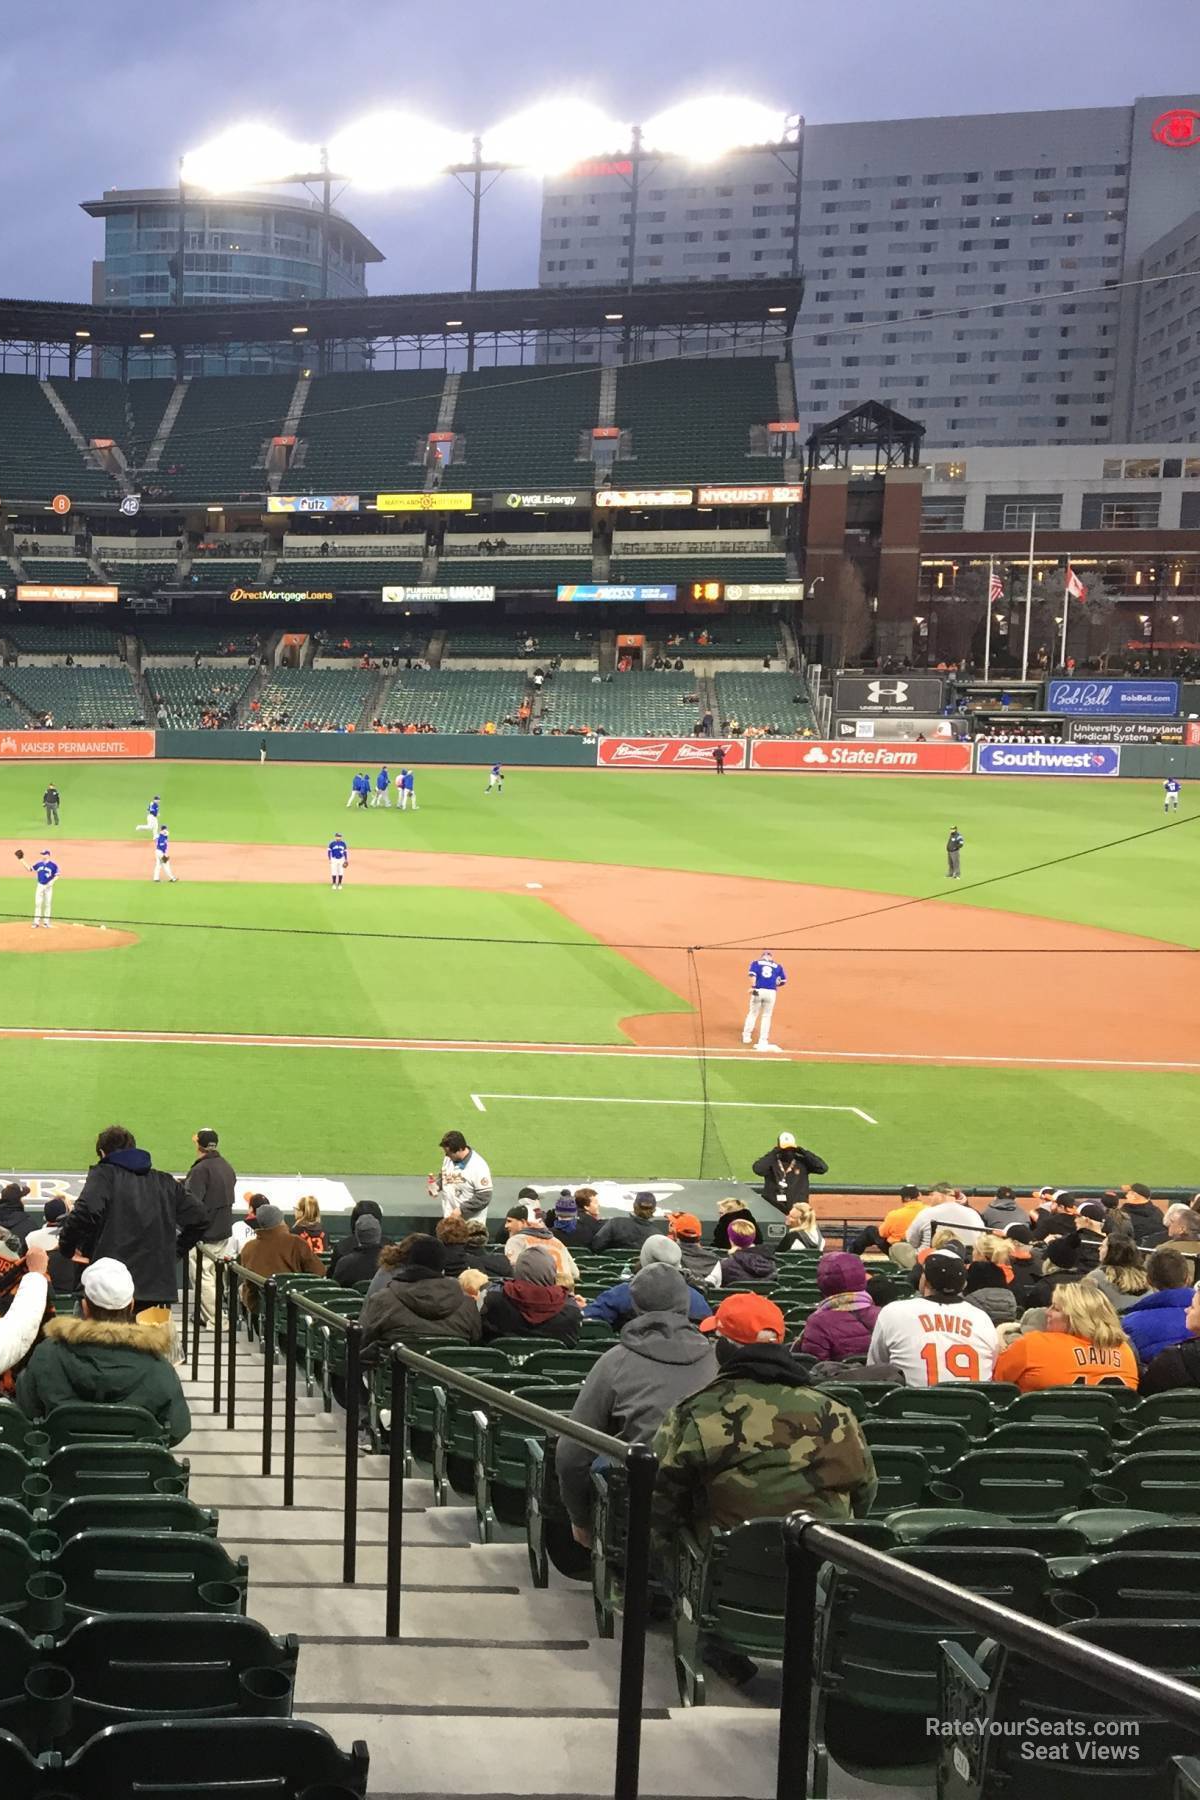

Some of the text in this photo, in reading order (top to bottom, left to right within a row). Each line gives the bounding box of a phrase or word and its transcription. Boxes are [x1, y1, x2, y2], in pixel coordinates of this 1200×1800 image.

[124, 500, 137, 511] 42
[230, 588, 333, 602] DirectMortgageLoans
[1052, 683, 1114, 706] Bob Bell
[1120, 694, 1171, 703] BobBell.com
[1073, 724, 1124, 735] University
[1126, 724, 1136, 733] of
[1138, 726, 1184, 735] Maryland
[582, 737, 596, 745] 364
[1073, 732, 1149, 743] Medical System
[21, 742, 126, 753] KAISER PERMANENTE
[992, 751, 1092, 767] Southwest
[761, 965, 773, 978] 8
[918, 1313, 973, 1338] DAVIS
[1074, 1346, 1122, 1368] DAVIS
[920, 1343, 980, 1386] 19
